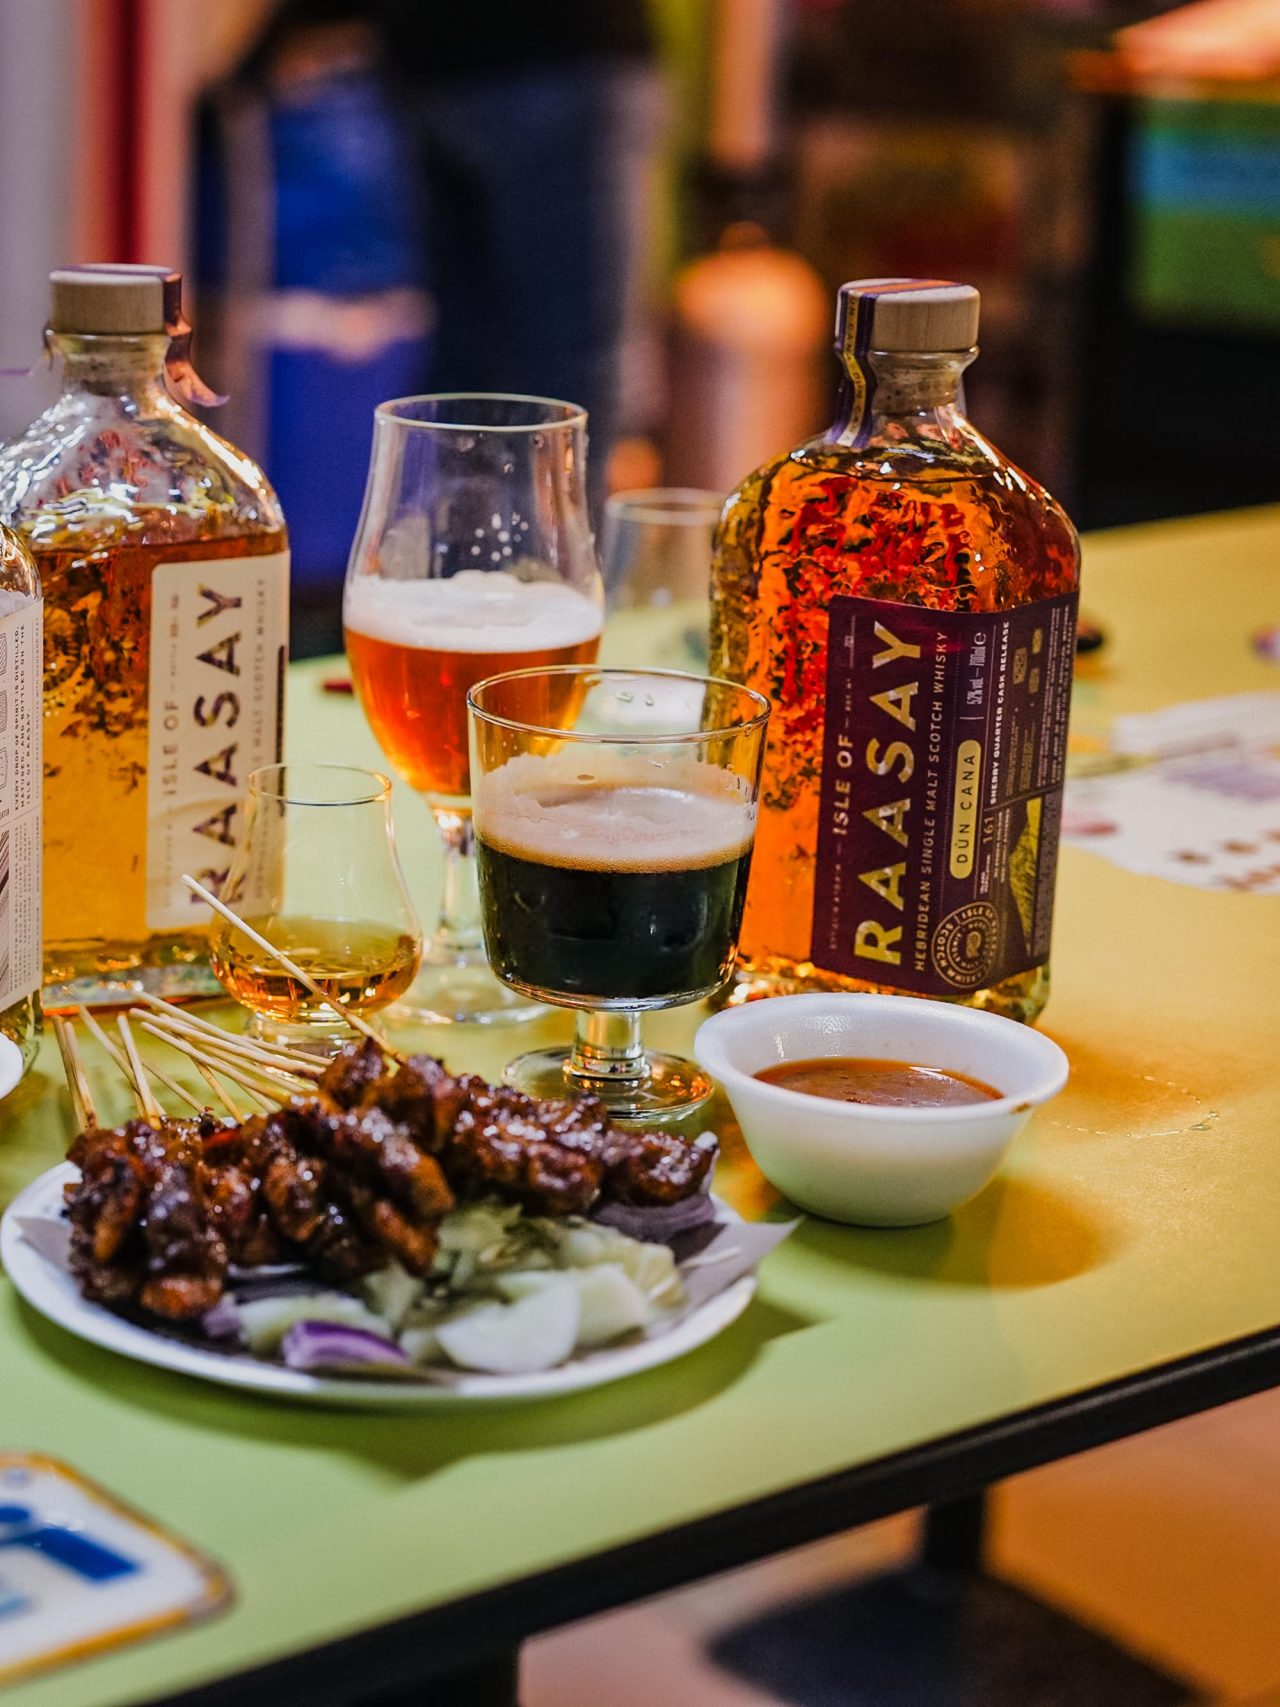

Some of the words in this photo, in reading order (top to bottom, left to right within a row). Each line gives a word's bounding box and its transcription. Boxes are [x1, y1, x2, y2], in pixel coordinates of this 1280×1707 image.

[932, 631, 949, 694] WHISKY
[999, 621, 1010, 672] RELEASE
[996, 674, 1005, 705] CASK
[163, 701, 179, 732] OF
[928, 700, 943, 763] SCOTCH
[992, 706, 1003, 759] QUARTER
[162, 744, 178, 796] ISLE
[190, 582, 244, 905] RAASAY
[835, 733, 854, 769] OF
[831, 778, 851, 836] ISLE
[852, 620, 922, 967] RAASAY
[924, 769, 939, 812] MALT
[959, 755, 976, 812] CANA
[990, 761, 1000, 805] SHERRY
[920, 818, 936, 875] SINGLE
[982, 815, 995, 844] 161
[914, 880, 931, 972] HEBRIDEAN
